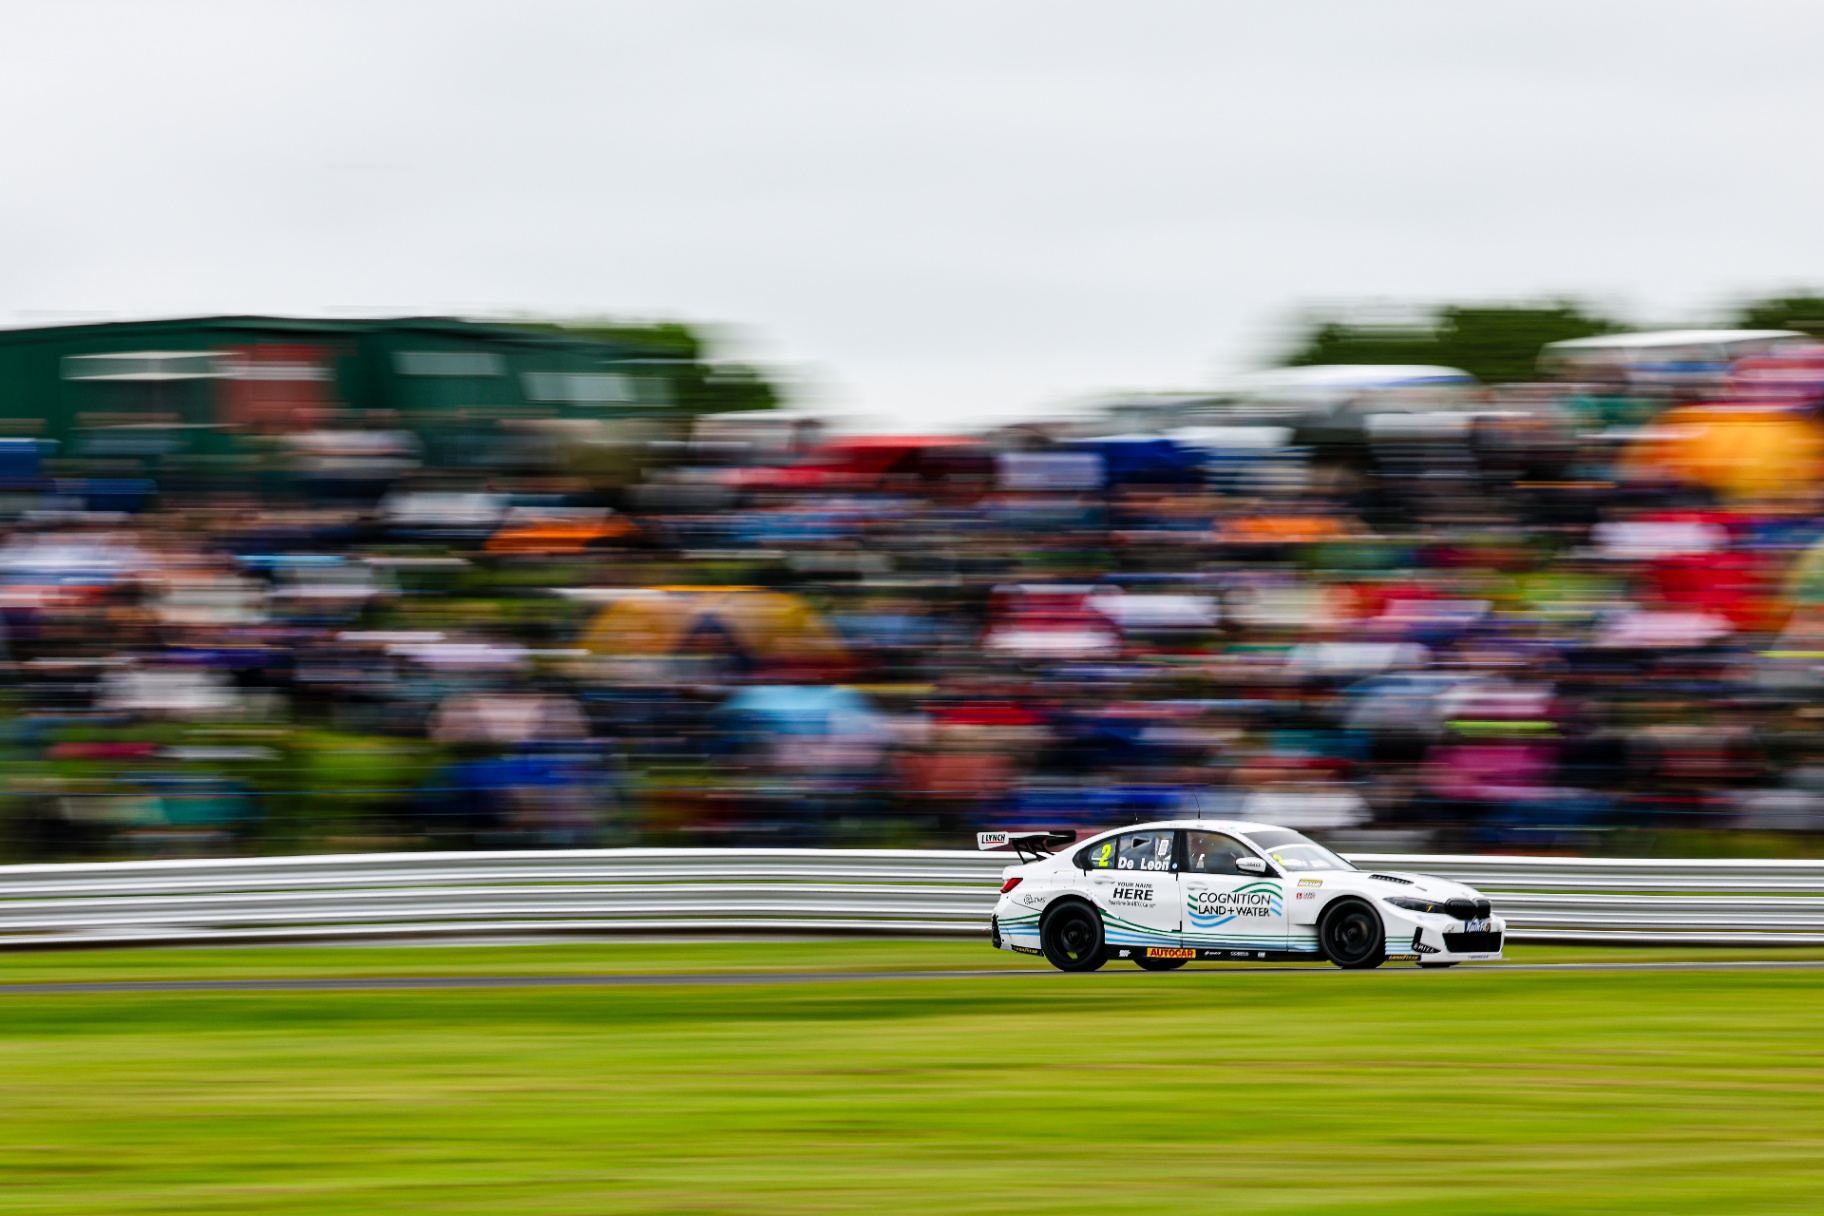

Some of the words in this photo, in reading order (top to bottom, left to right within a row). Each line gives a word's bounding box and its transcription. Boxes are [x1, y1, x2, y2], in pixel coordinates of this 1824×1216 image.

[1098, 843, 1112, 867] 2
[1117, 856, 1134, 869] De
[1140, 857, 1170, 870] Leon
[1112, 887, 1154, 900] HERE
[1198, 892, 1271, 905] COGNITION
[1198, 904, 1226, 915] LAND
[1235, 906, 1270, 917] WATER
[1150, 948, 1194, 958] AUTOCAR
